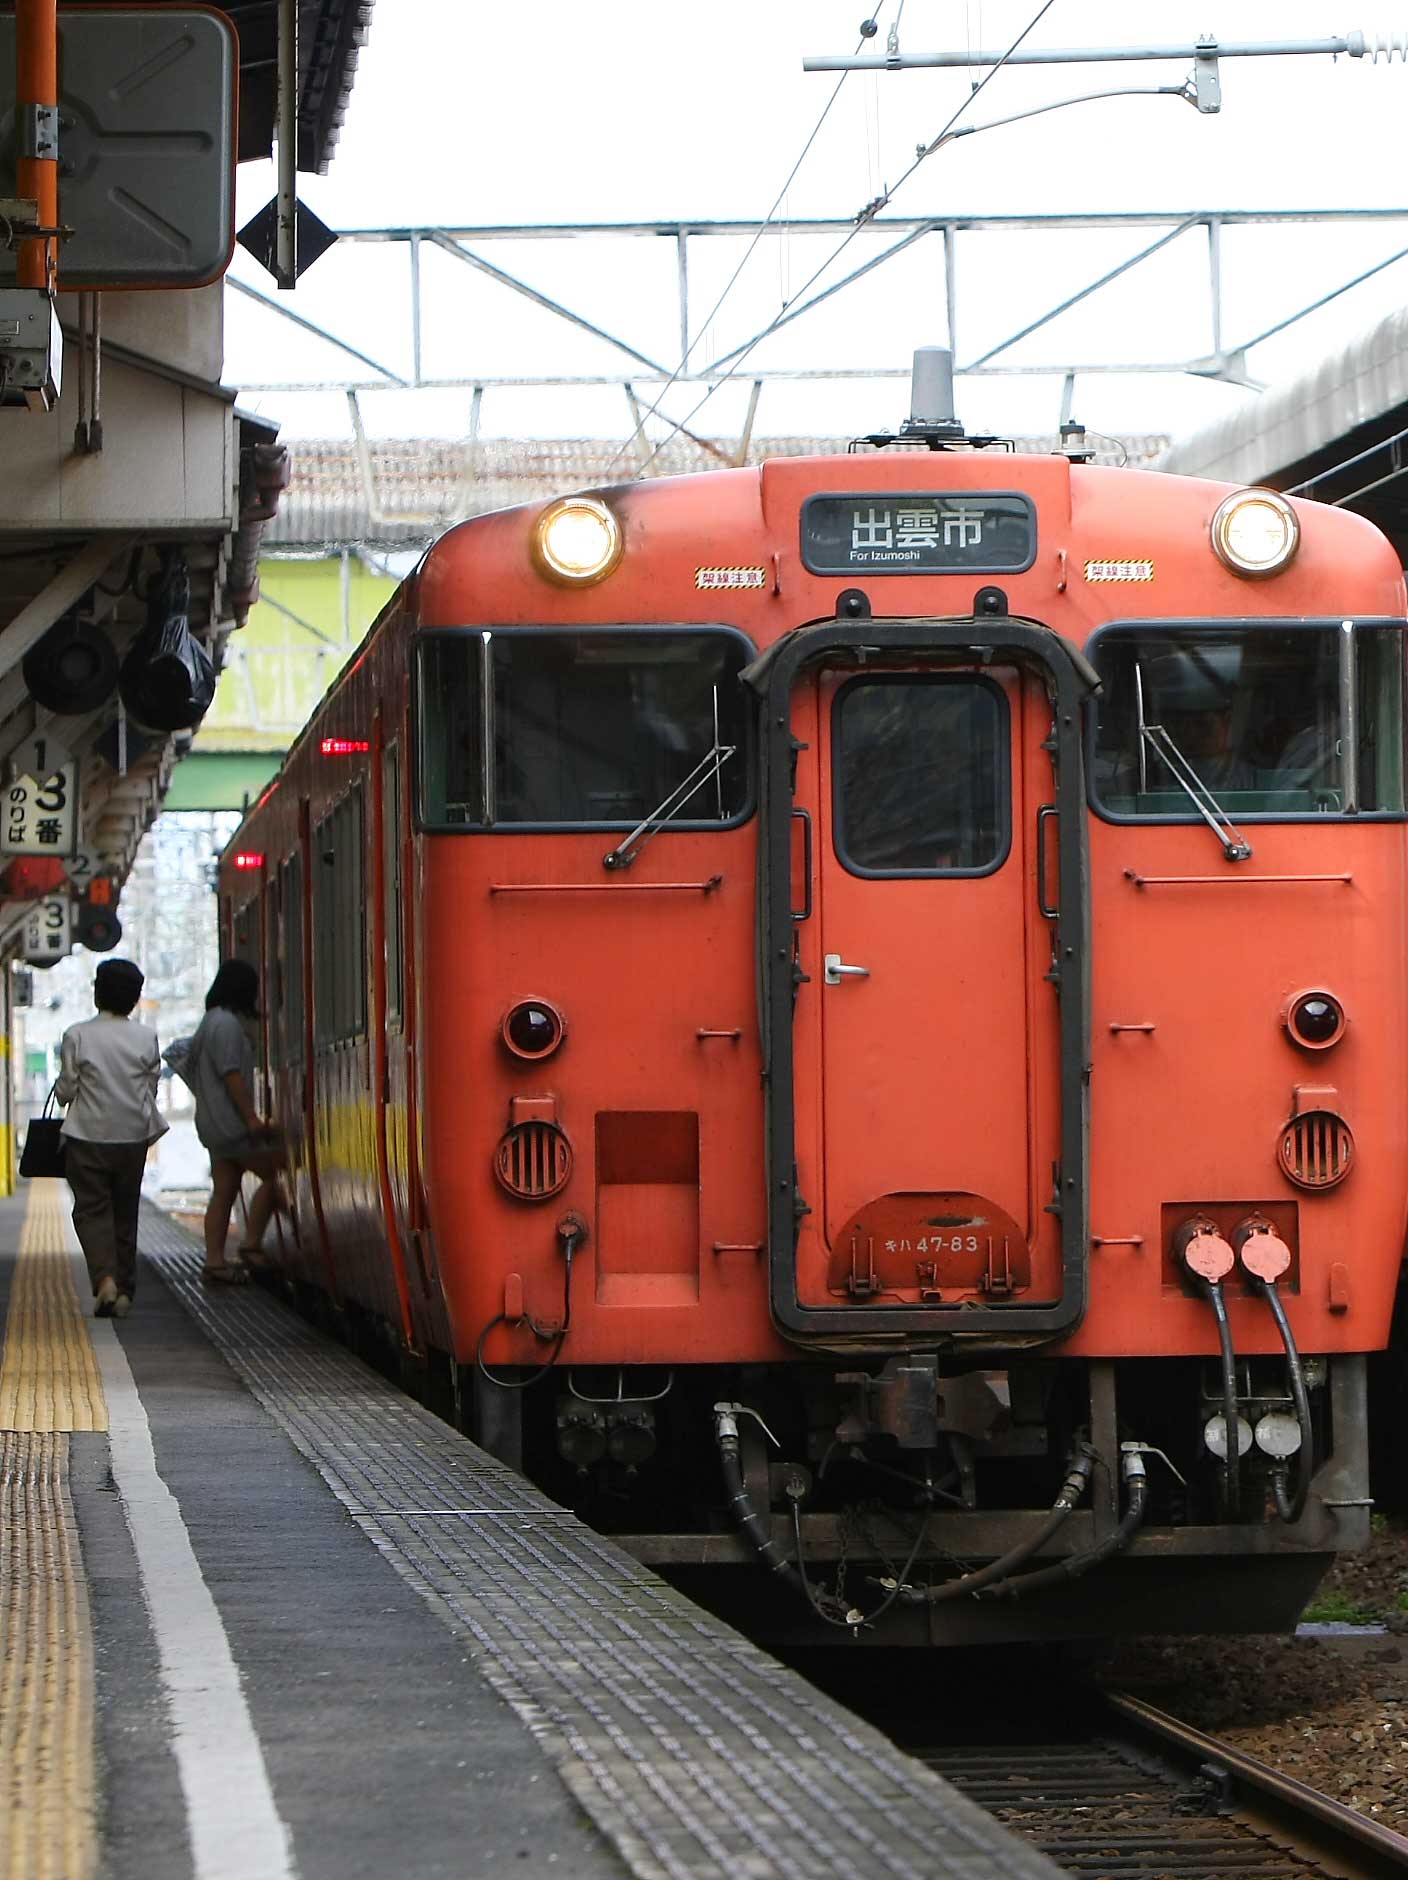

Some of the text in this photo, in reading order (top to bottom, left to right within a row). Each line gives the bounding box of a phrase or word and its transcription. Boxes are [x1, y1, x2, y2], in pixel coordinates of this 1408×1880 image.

[852, 507, 985, 549] 出雲市
[850, 551, 920, 561] For Izumoshi
[8, 787, 27, 842] のりば
